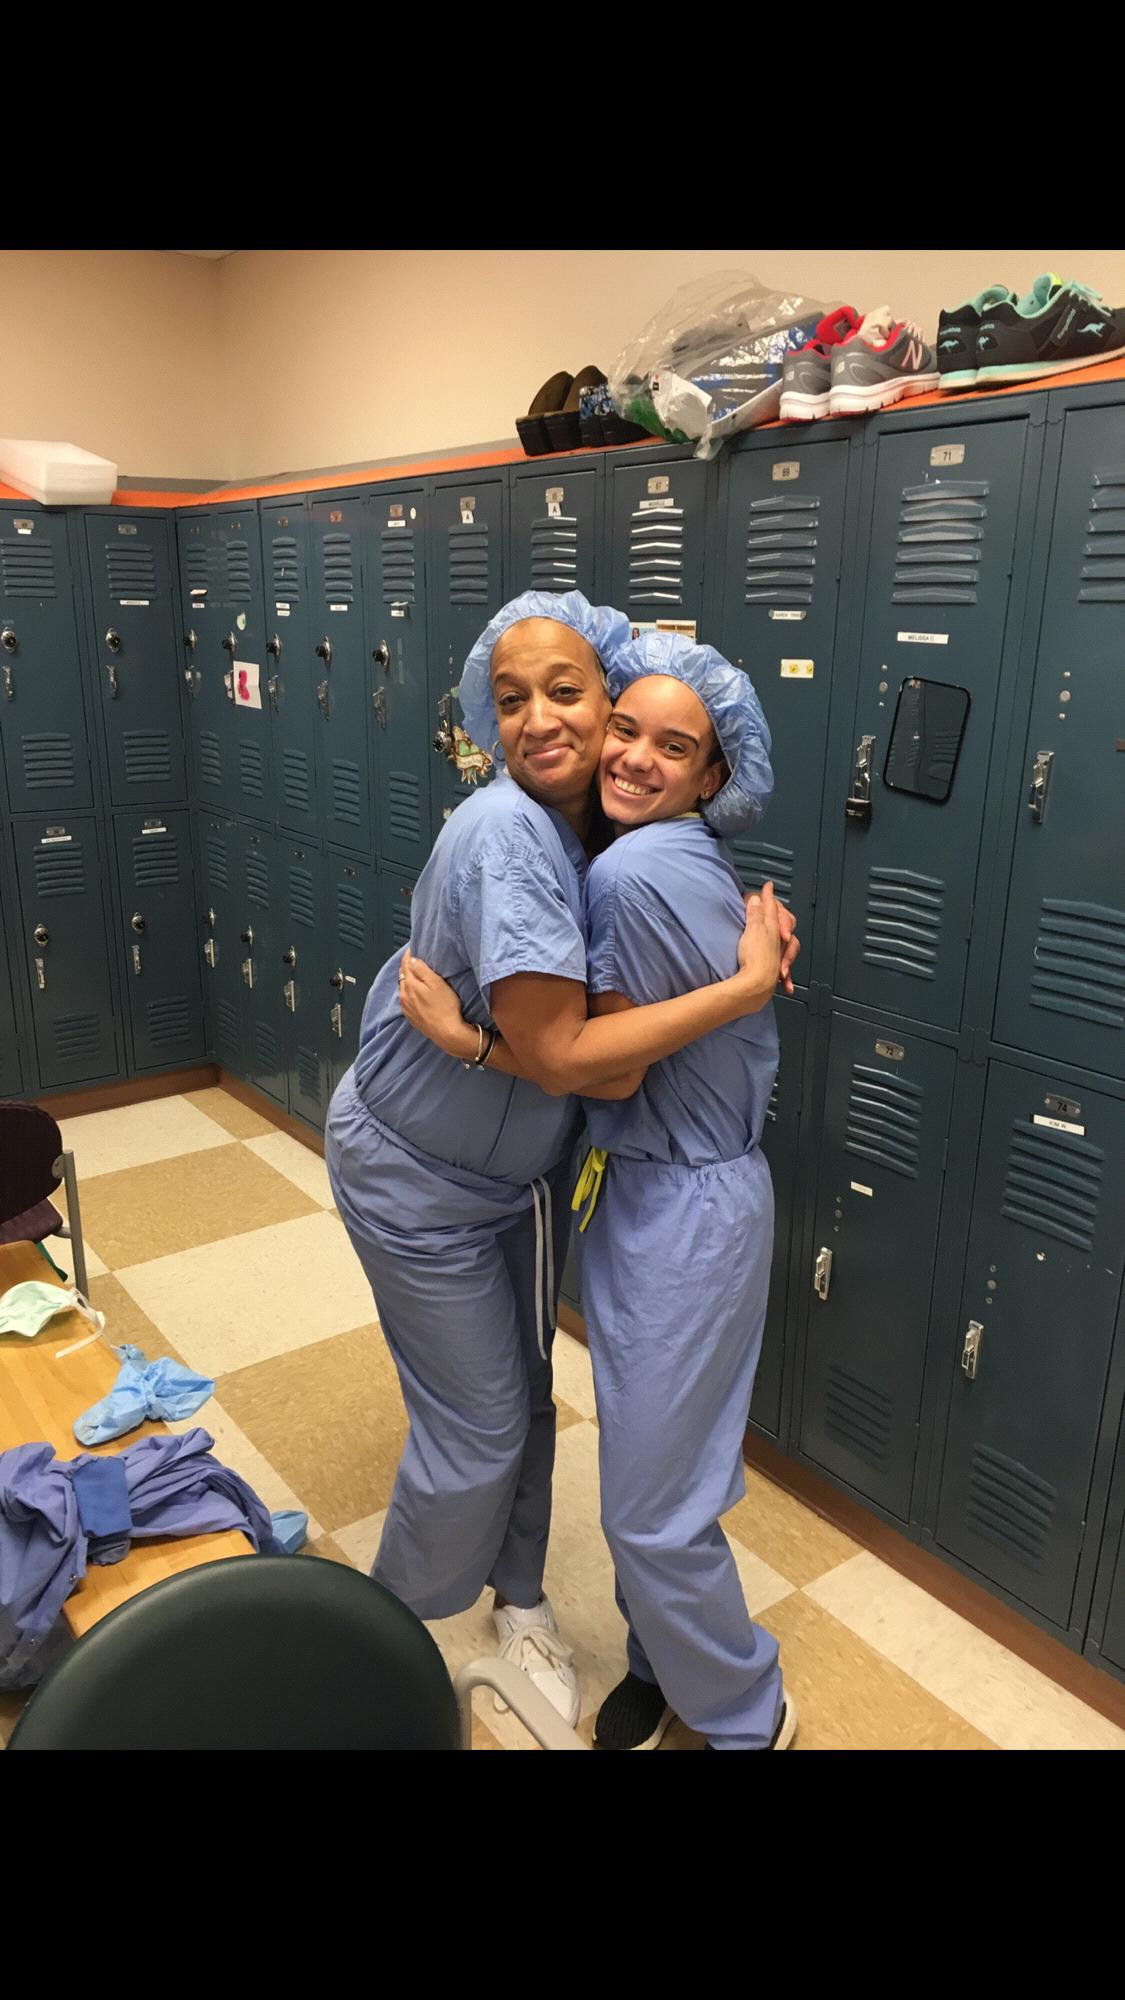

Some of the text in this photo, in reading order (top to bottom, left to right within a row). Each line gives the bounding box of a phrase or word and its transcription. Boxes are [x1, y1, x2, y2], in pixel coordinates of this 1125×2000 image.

[901, 339, 923, 371] N
[943, 451, 952, 462] 71
[1056, 1101, 1068, 1113] 74
